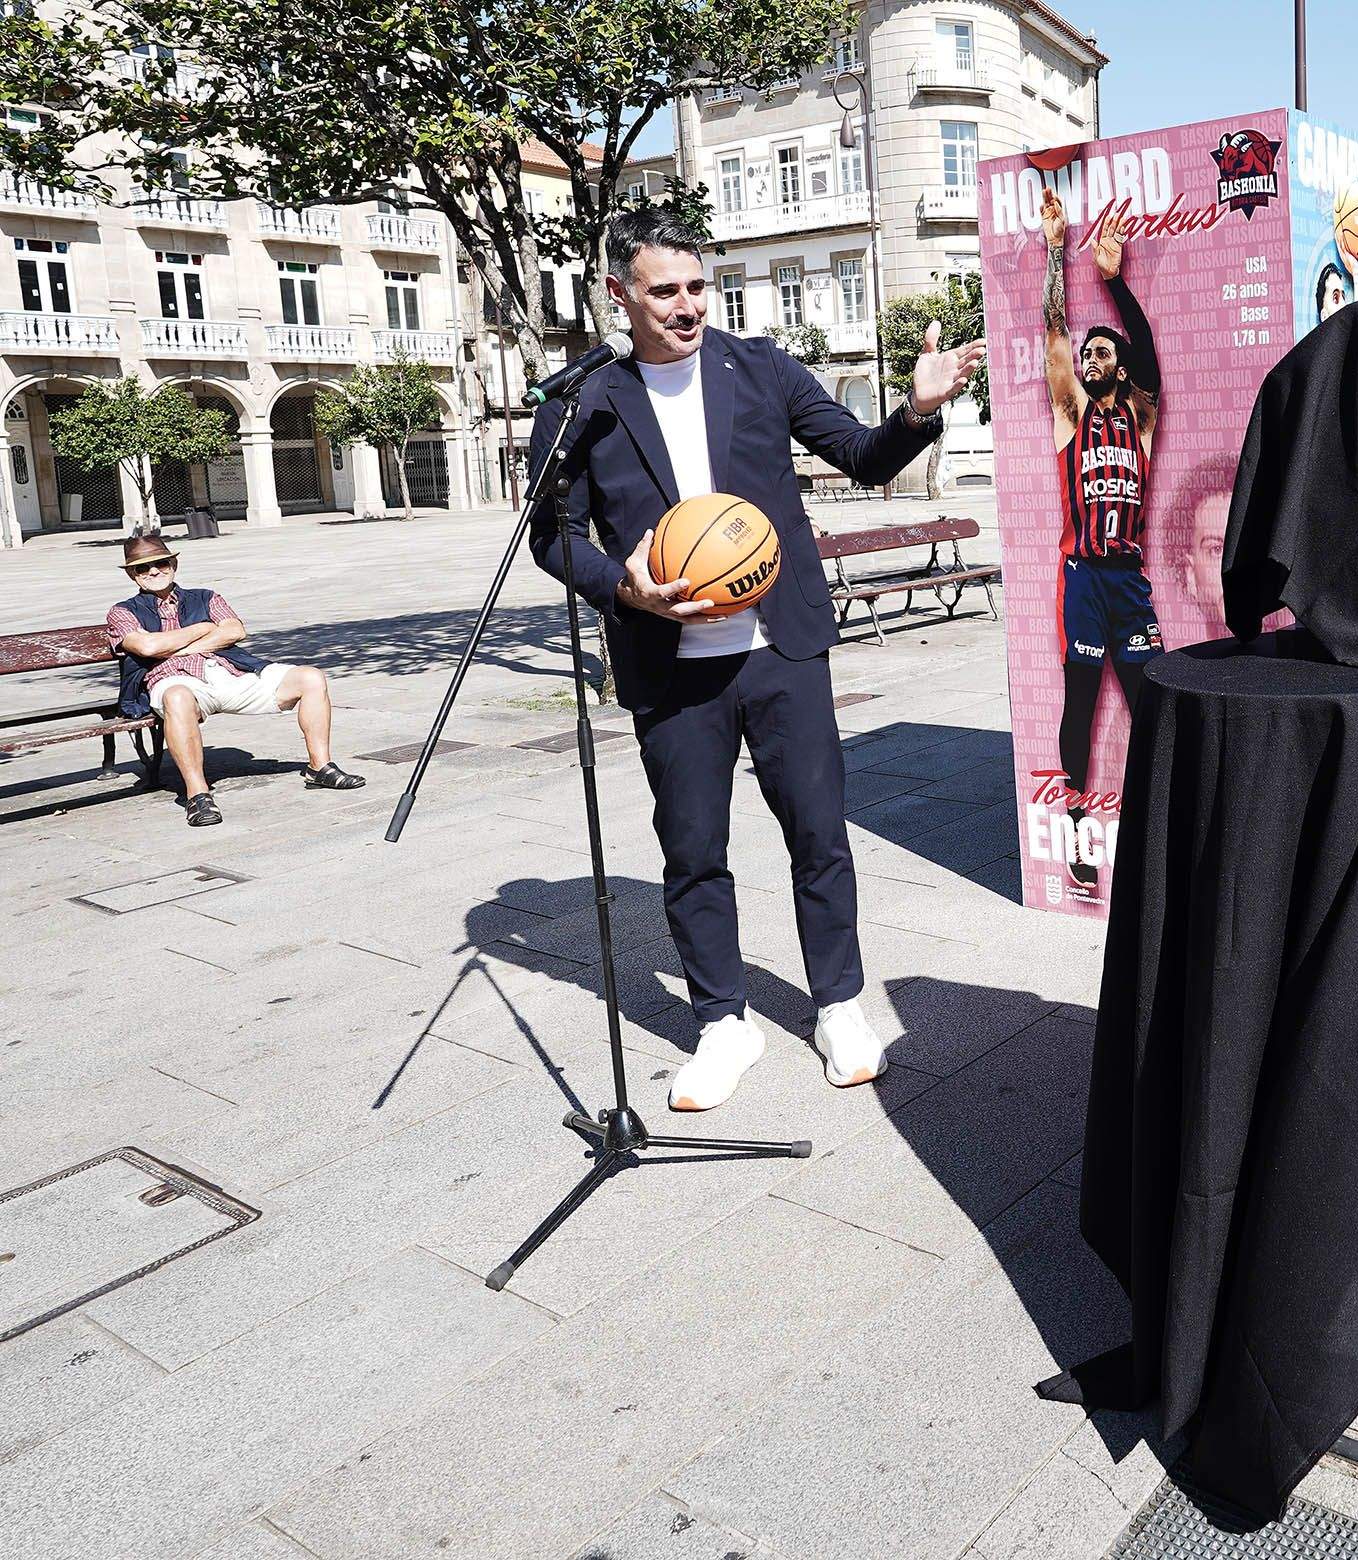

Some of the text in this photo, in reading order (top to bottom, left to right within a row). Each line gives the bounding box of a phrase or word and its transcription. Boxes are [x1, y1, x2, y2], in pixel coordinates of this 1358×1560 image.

[990, 147, 1174, 235] HOWARD
[1220, 174, 1276, 202] BASKONIA
[1077, 193, 1228, 251] Markus
[1246, 256, 1268, 273] USA
[1222, 282, 1269, 301] 26 anos
[1240, 306, 1269, 323] Base
[1233, 328, 1270, 348] 1,78 m
[723, 518, 748, 540] FIBA
[1105, 510, 1119, 539] 0
[725, 541, 782, 598] Wilso
[1031, 770, 1121, 812] Torne
